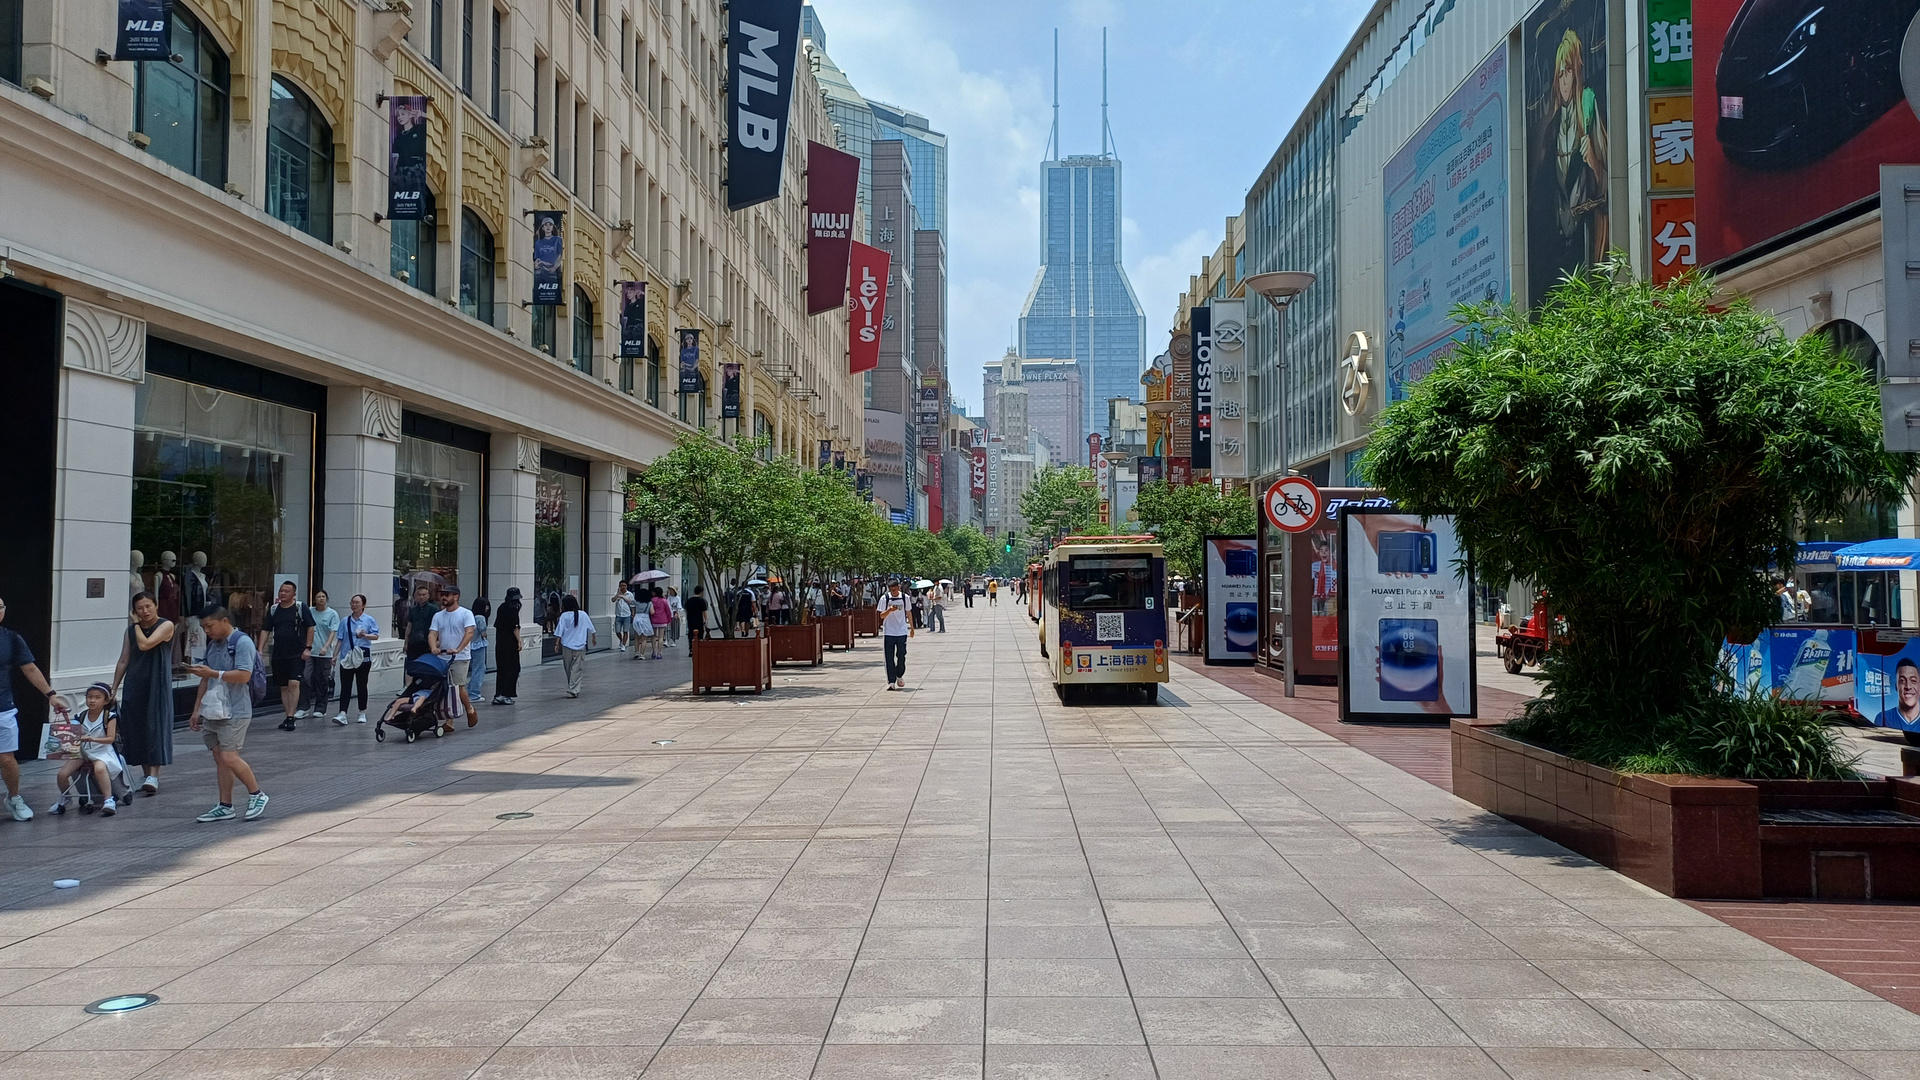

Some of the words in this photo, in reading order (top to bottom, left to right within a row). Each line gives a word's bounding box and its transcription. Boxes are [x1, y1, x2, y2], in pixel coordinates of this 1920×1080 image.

[125, 20, 164, 31] MLB
[738, 20, 779, 152] MLB
[812, 213, 850, 230] MUJI
[815, 230, 846, 239] 無印良品
[878, 206, 896, 331] 上海场
[1044, 372, 1068, 380] PLAZA
[1197, 331, 1211, 411] TISSOT
[1219, 362, 1241, 457] 创趣场
[973, 456, 986, 490] KFC
[989, 448, 997, 504] BOSIDENG
[1405, 588, 1421, 596] Pura
[1147, 599, 1153, 608] 9
[1384, 601, 1432, 610] 岂止于阔
[1402, 632, 1415, 640] 08
[1402, 641, 1415, 649] 08
[1097, 654, 1147, 666] 上海梅林
